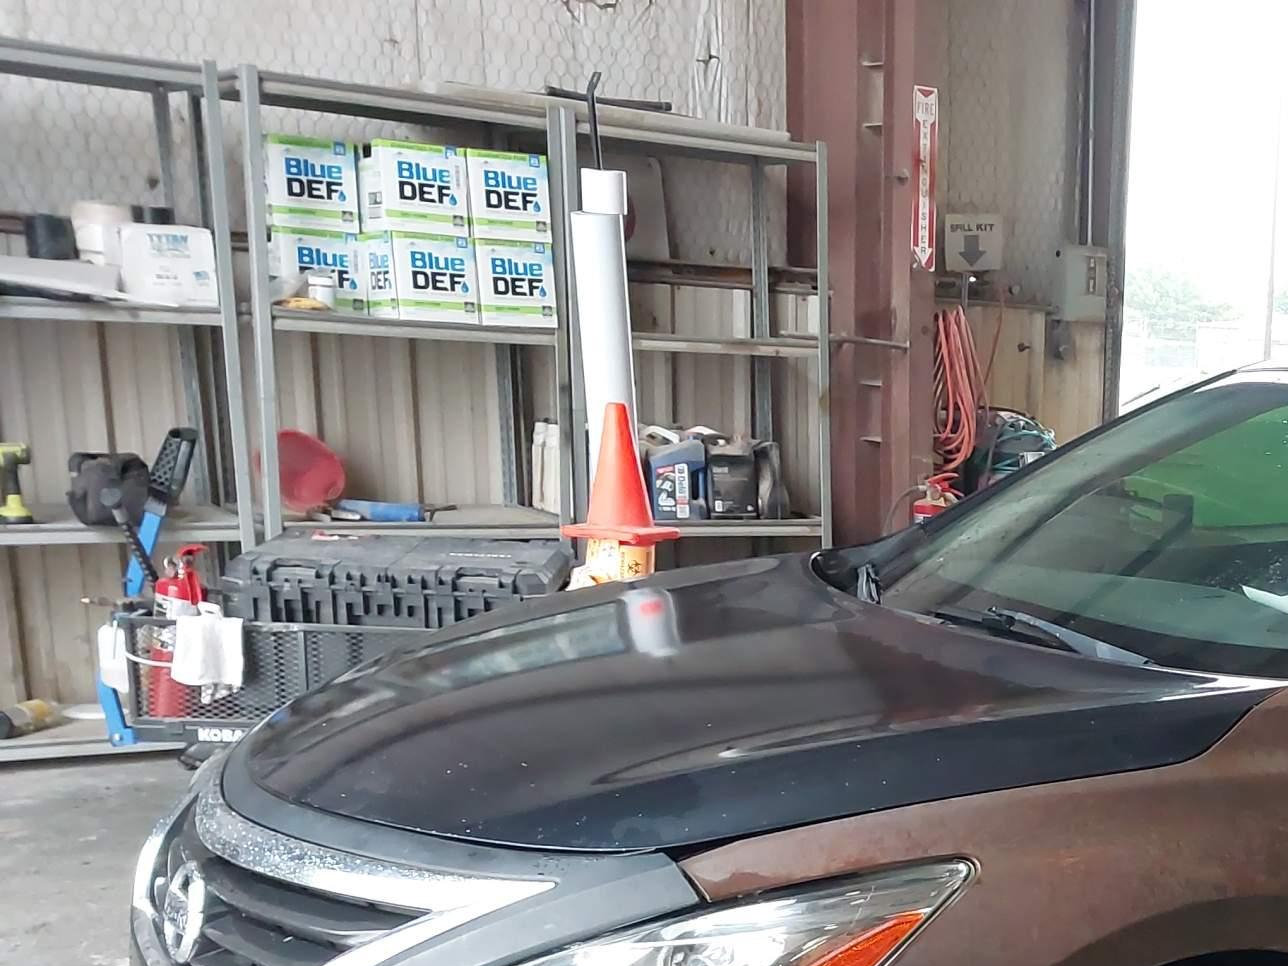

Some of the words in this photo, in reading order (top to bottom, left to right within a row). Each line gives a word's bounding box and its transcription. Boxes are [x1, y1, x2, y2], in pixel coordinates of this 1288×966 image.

[916, 101, 935, 116] FIRE
[284, 156, 342, 180] Blue
[396, 160, 451, 184] Blue
[286, 177, 343, 200] DEF
[483, 169, 538, 192] Blue
[398, 180, 451, 204] DEF
[485, 189, 538, 211] DEF
[950, 223, 974, 233] SPILL
[975, 223, 995, 232] KIT
[297, 246, 349, 269] Blue
[368, 252, 389, 270] Blue
[410, 250, 465, 272] Blue
[491, 257, 543, 277] Blue
[370, 270, 391, 290] DEF
[411, 270, 465, 292] DEF
[492, 276, 543, 297] DEF
